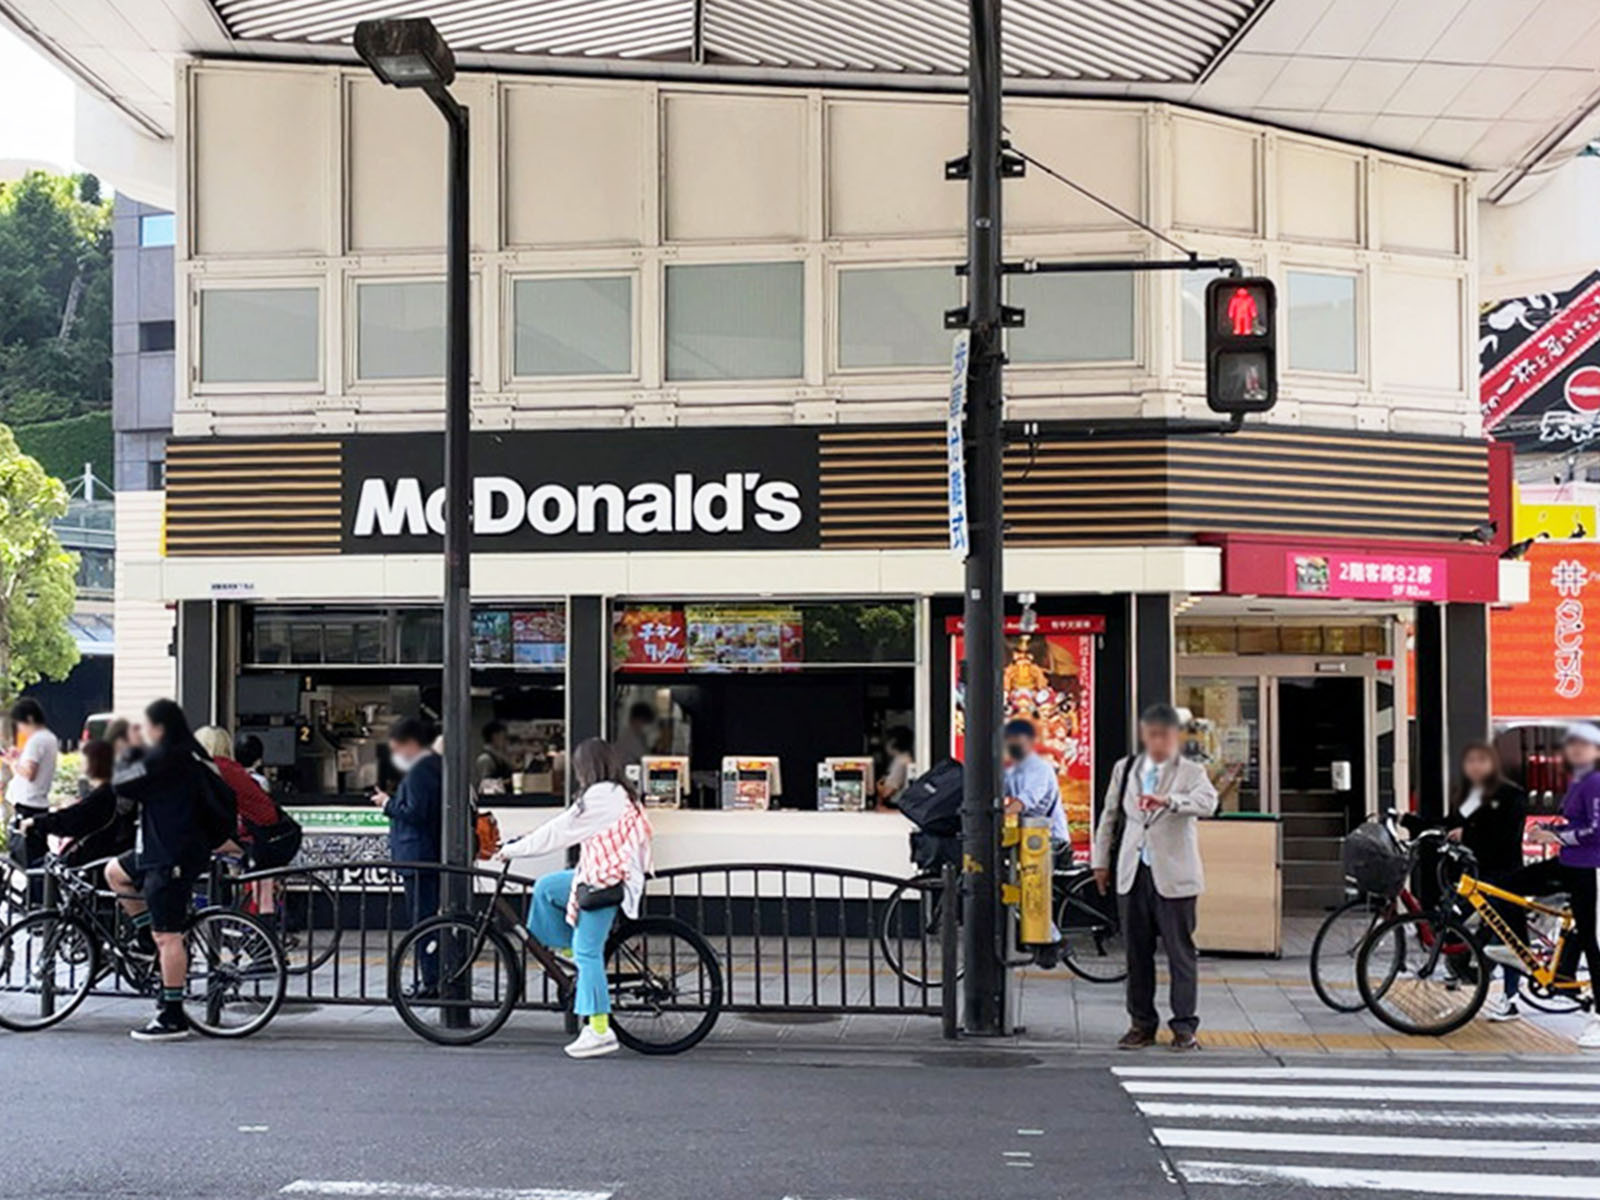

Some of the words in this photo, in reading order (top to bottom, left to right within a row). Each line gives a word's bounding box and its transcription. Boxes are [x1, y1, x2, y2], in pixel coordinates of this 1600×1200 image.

[353, 473, 802, 536] McDonald's
[301, 727, 310, 742] 2
[1479, 902, 1541, 971] HUMMER
